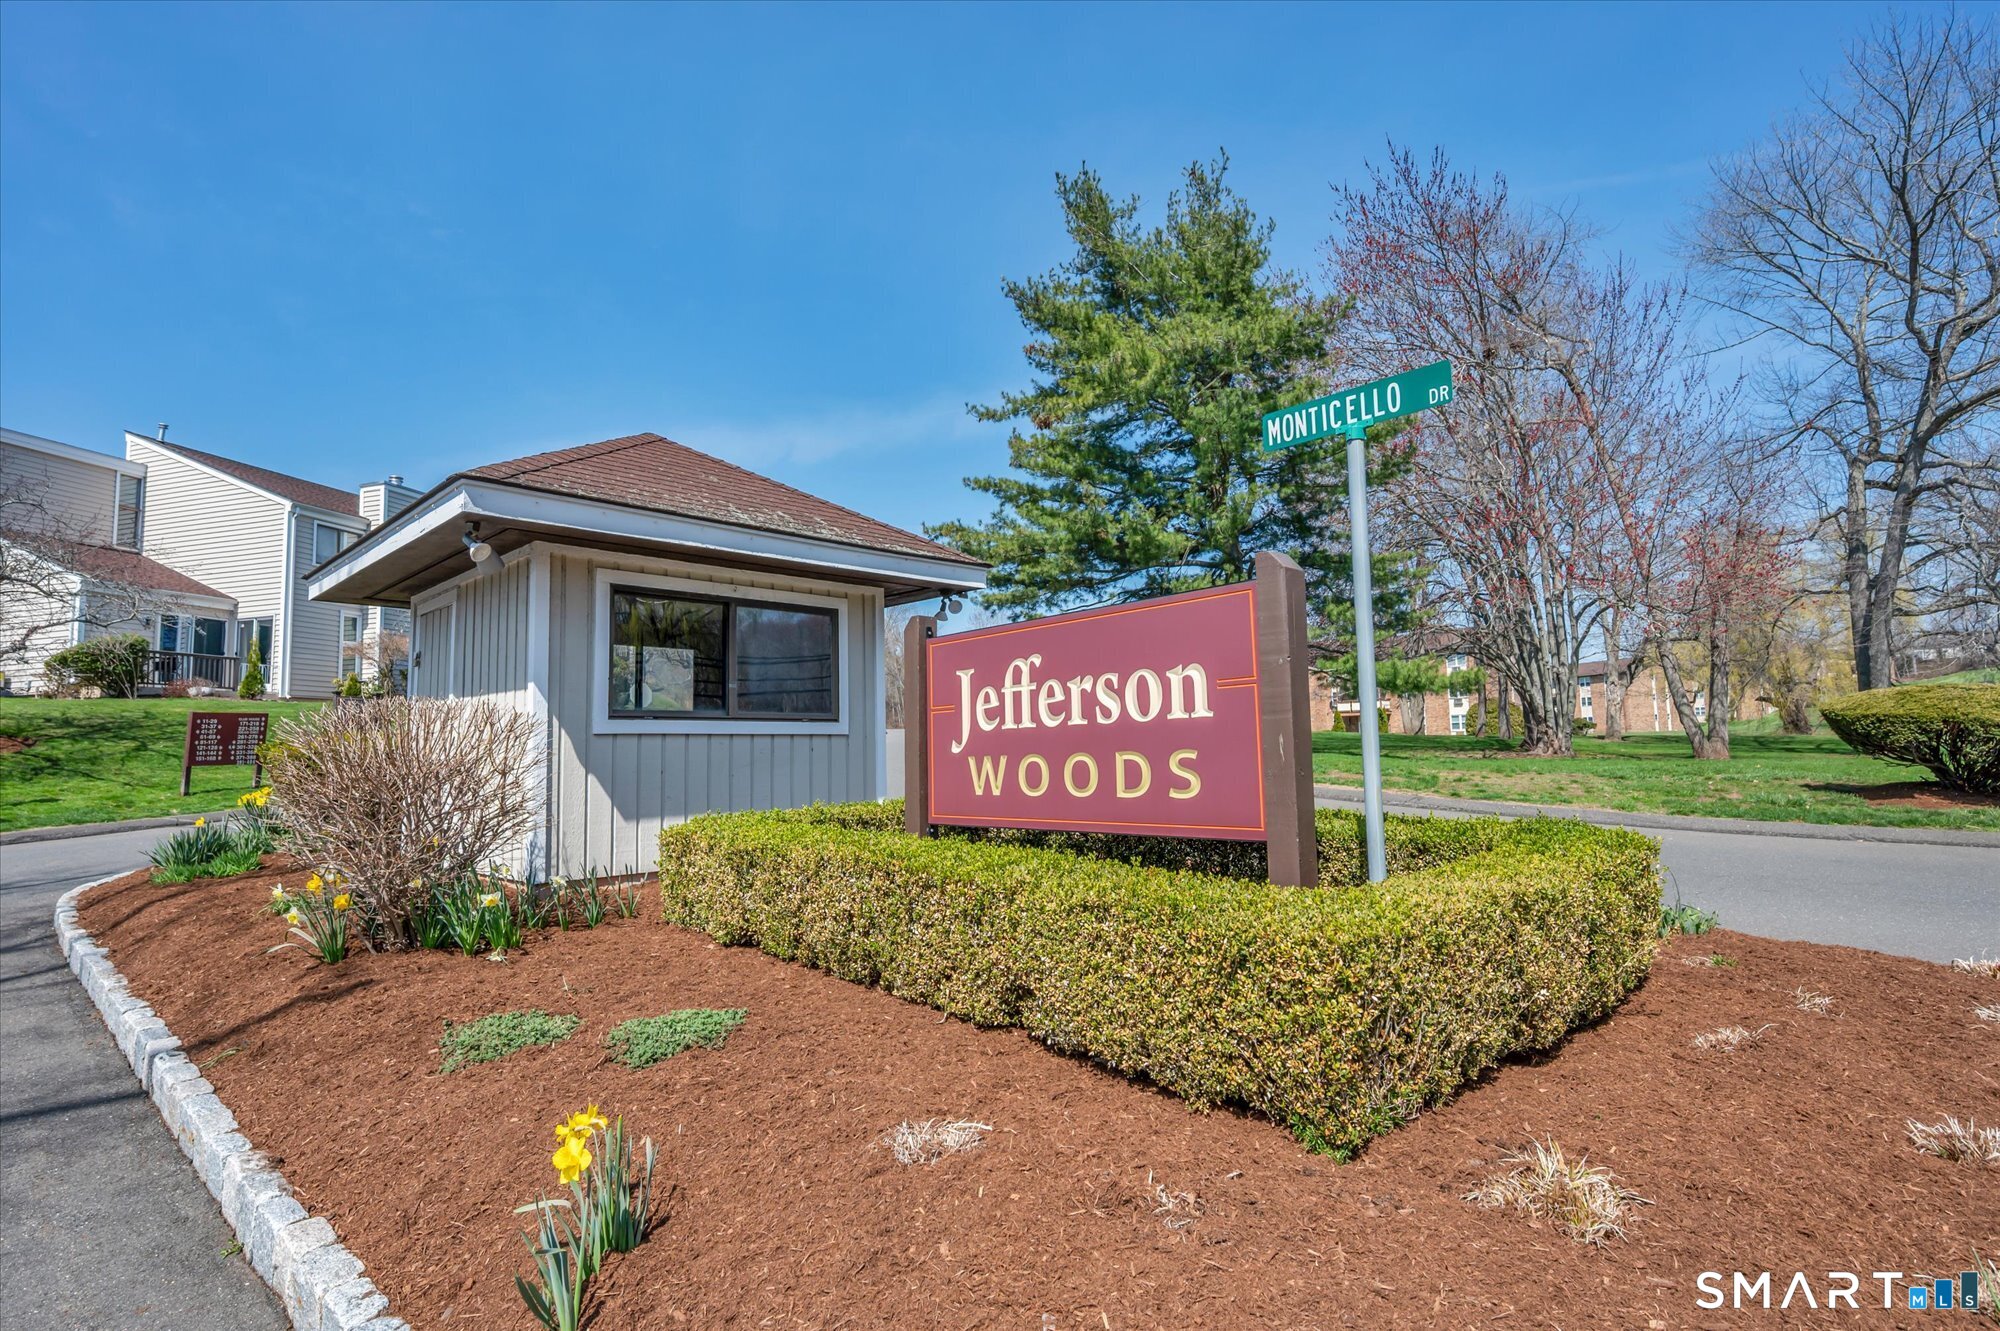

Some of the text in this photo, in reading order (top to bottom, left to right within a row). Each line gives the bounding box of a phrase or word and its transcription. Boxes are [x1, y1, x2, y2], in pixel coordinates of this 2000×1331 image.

[1268, 382, 1449, 446] MONTICELLO DR
[951, 653, 1214, 754] Jefferson
[967, 749, 1202, 800] WOODS
